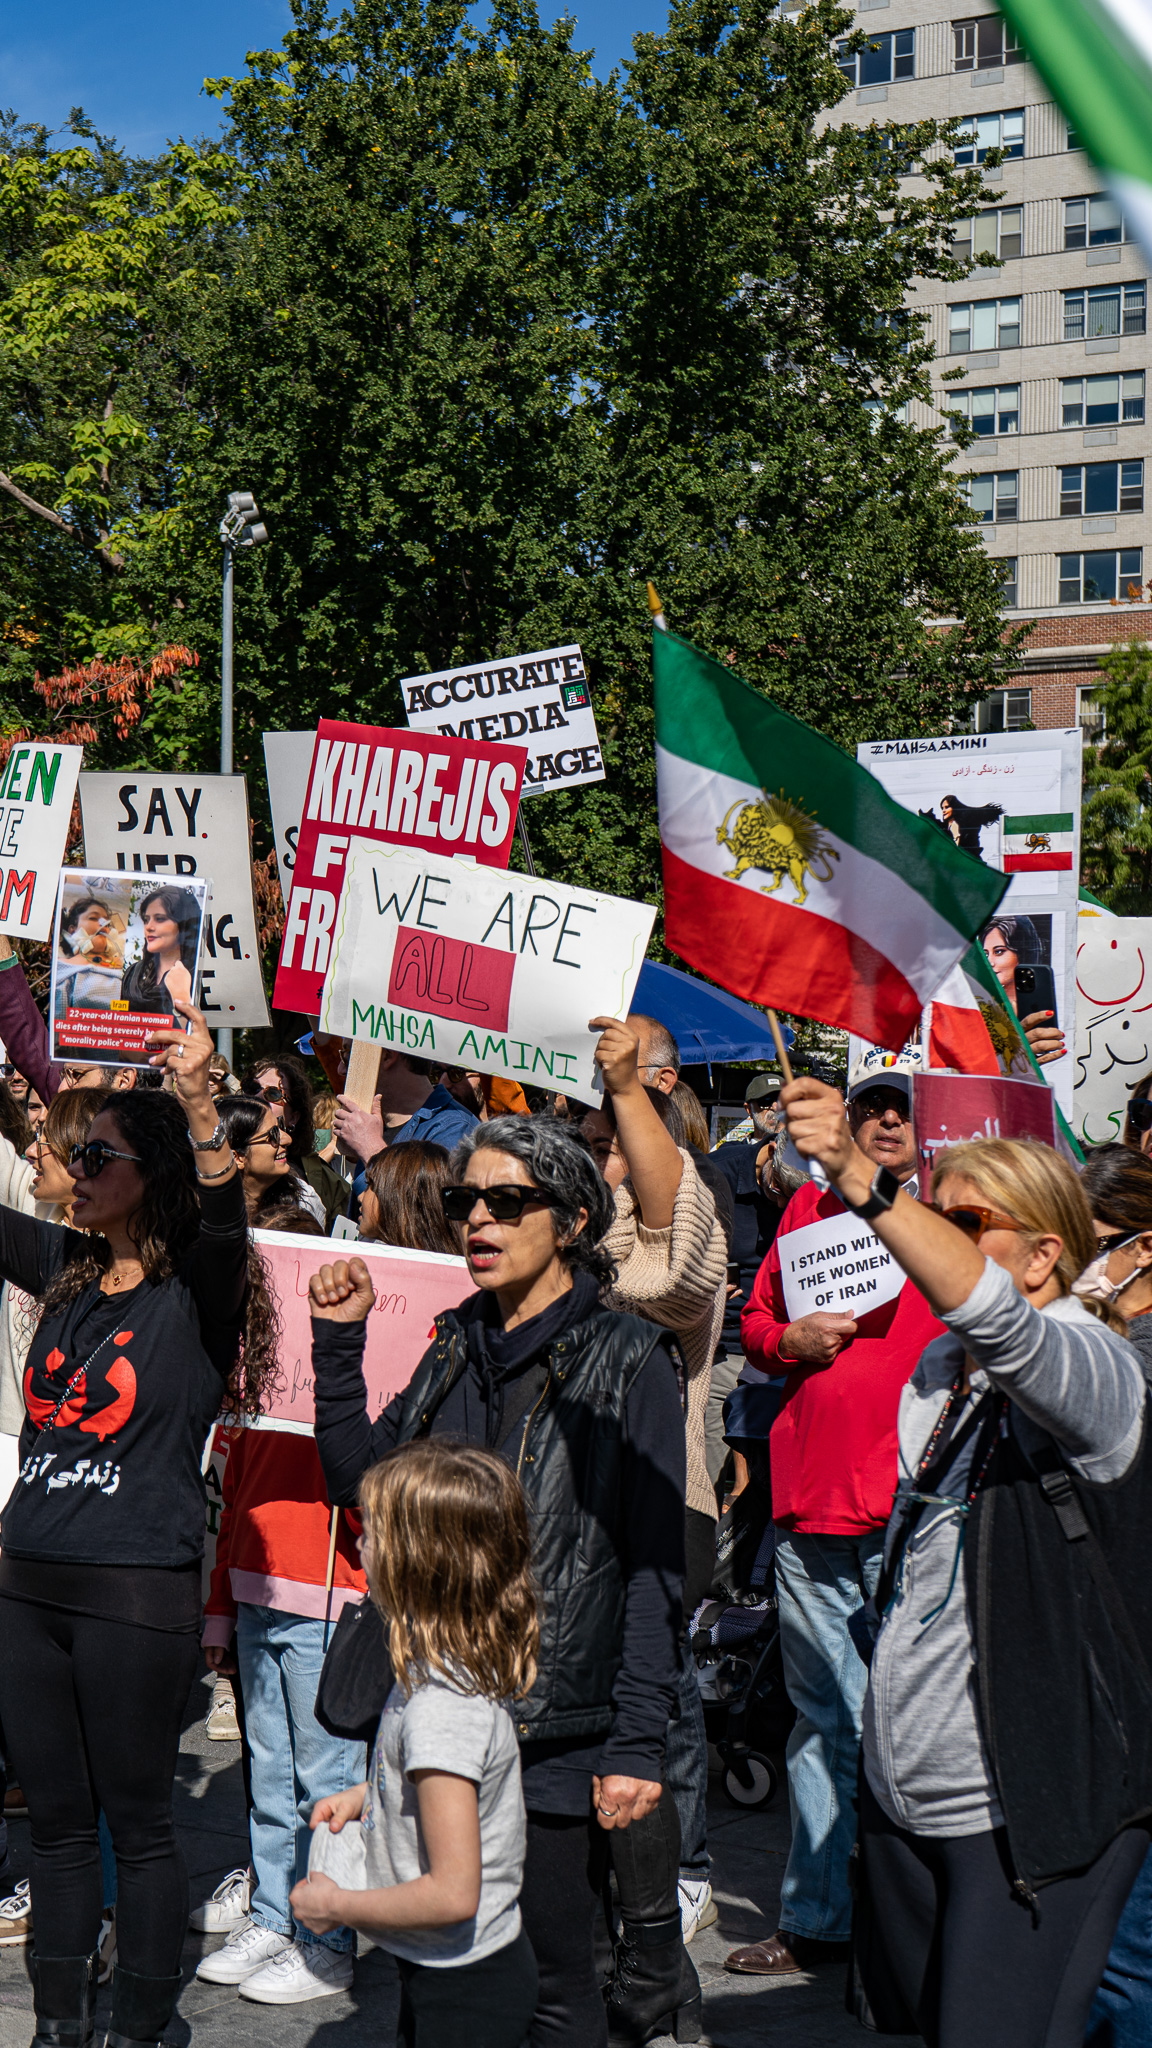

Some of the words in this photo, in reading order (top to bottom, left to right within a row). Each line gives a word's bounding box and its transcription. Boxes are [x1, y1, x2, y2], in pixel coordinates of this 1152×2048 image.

[407, 653, 585, 714] ACCURATE
[437, 701, 569, 742] MEDIA
[306, 738, 517, 847] KHAREJIS
[372, 867, 451, 929] WE
[481, 891, 597, 969] ARE
[395, 936, 489, 1011] ALL
[69, 1009, 113, 1021] 22-year-old
[114, 1013, 140, 1023] Iranian
[142, 1016, 169, 1025] woman
[112, 1001, 127, 1009] Iran
[55, 1021, 71, 1030] dies
[71, 1023, 91, 1032] after
[91, 1024, 113, 1034] being
[113, 1027, 144, 1037] severely
[124, 1041, 141, 1049] over
[352, 998, 436, 1050] MAHSA
[458, 1030, 578, 1083] AMINI
[791, 1261, 796, 1272] I
[799, 1243, 847, 1269] STAND
[850, 1234, 880, 1252] WIT
[798, 1271, 827, 1290] THE
[829, 1253, 891, 1280] WOMEN
[815, 1291, 834, 1307] OF
[839, 1279, 877, 1300] IRAN
[47, 1459, 120, 1496] زندگی
